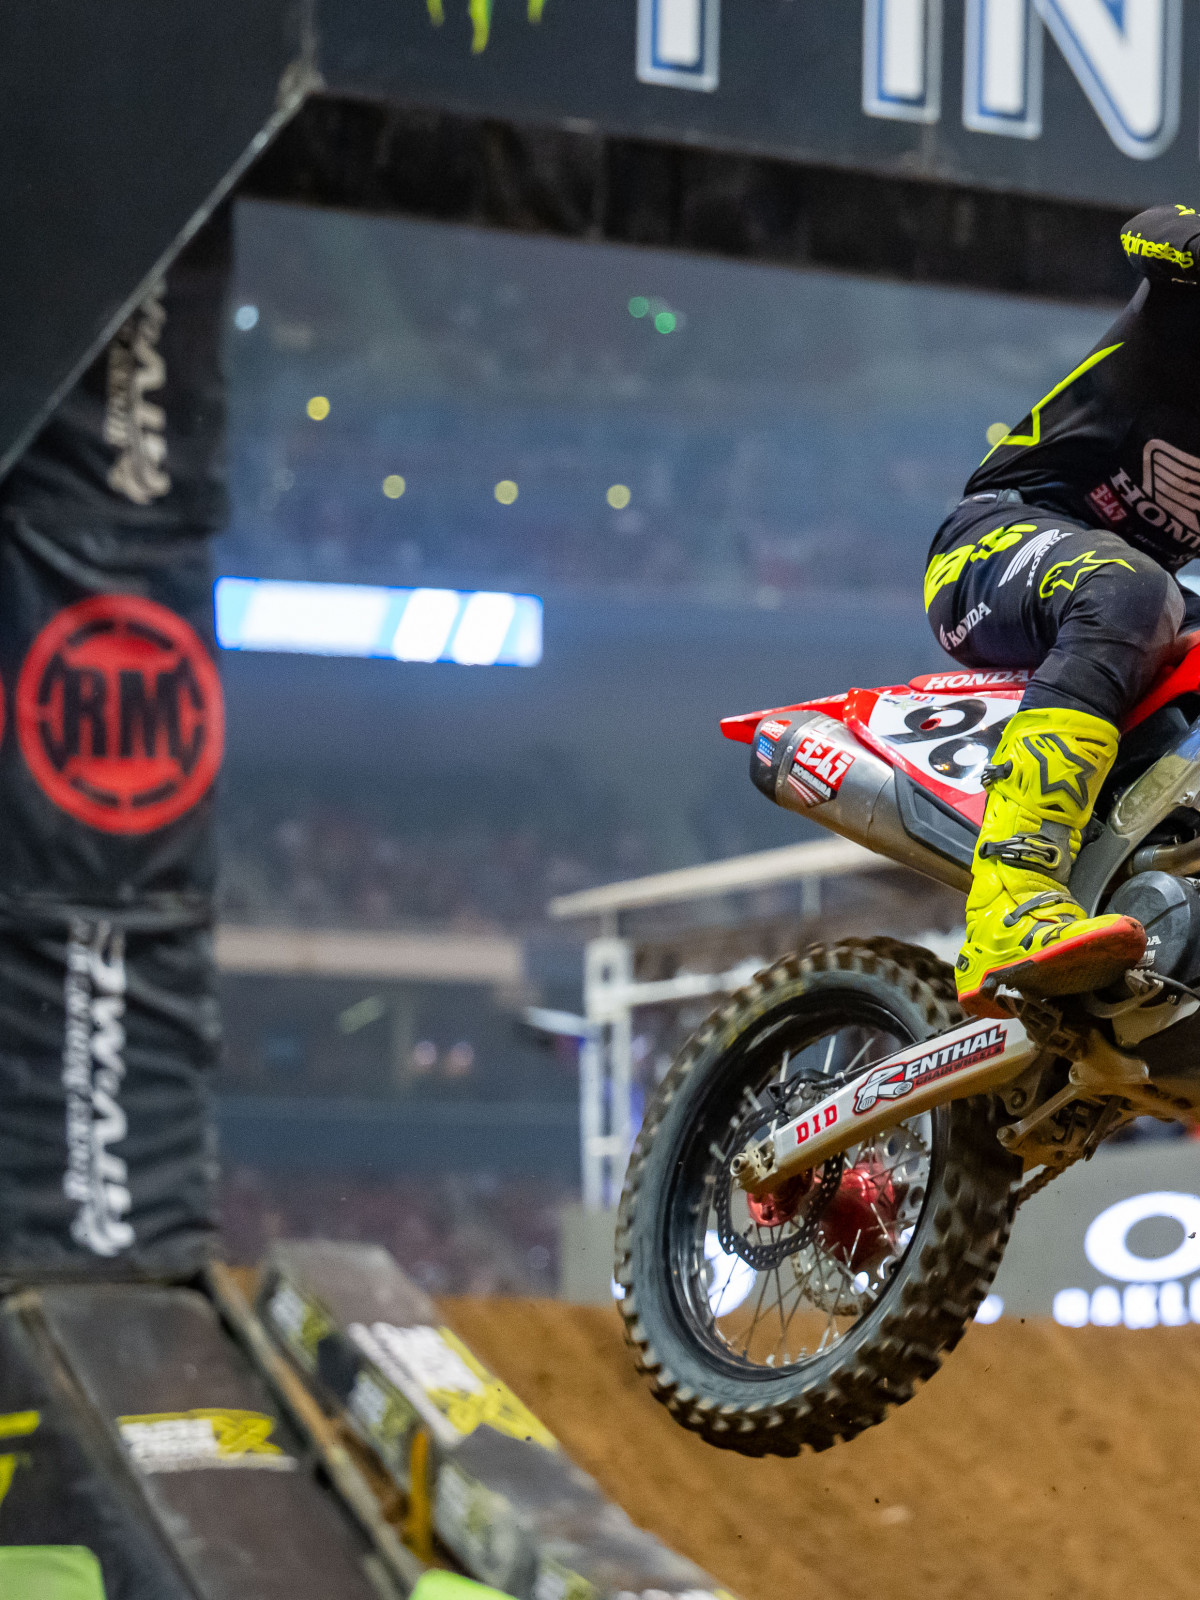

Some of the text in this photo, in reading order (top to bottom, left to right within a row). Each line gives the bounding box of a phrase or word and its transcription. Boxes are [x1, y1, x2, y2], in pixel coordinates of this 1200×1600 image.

[56, 668, 184, 762] RM
[923, 669, 1030, 692] HONDA
[856, 1024, 1005, 1113] RENTHAL
